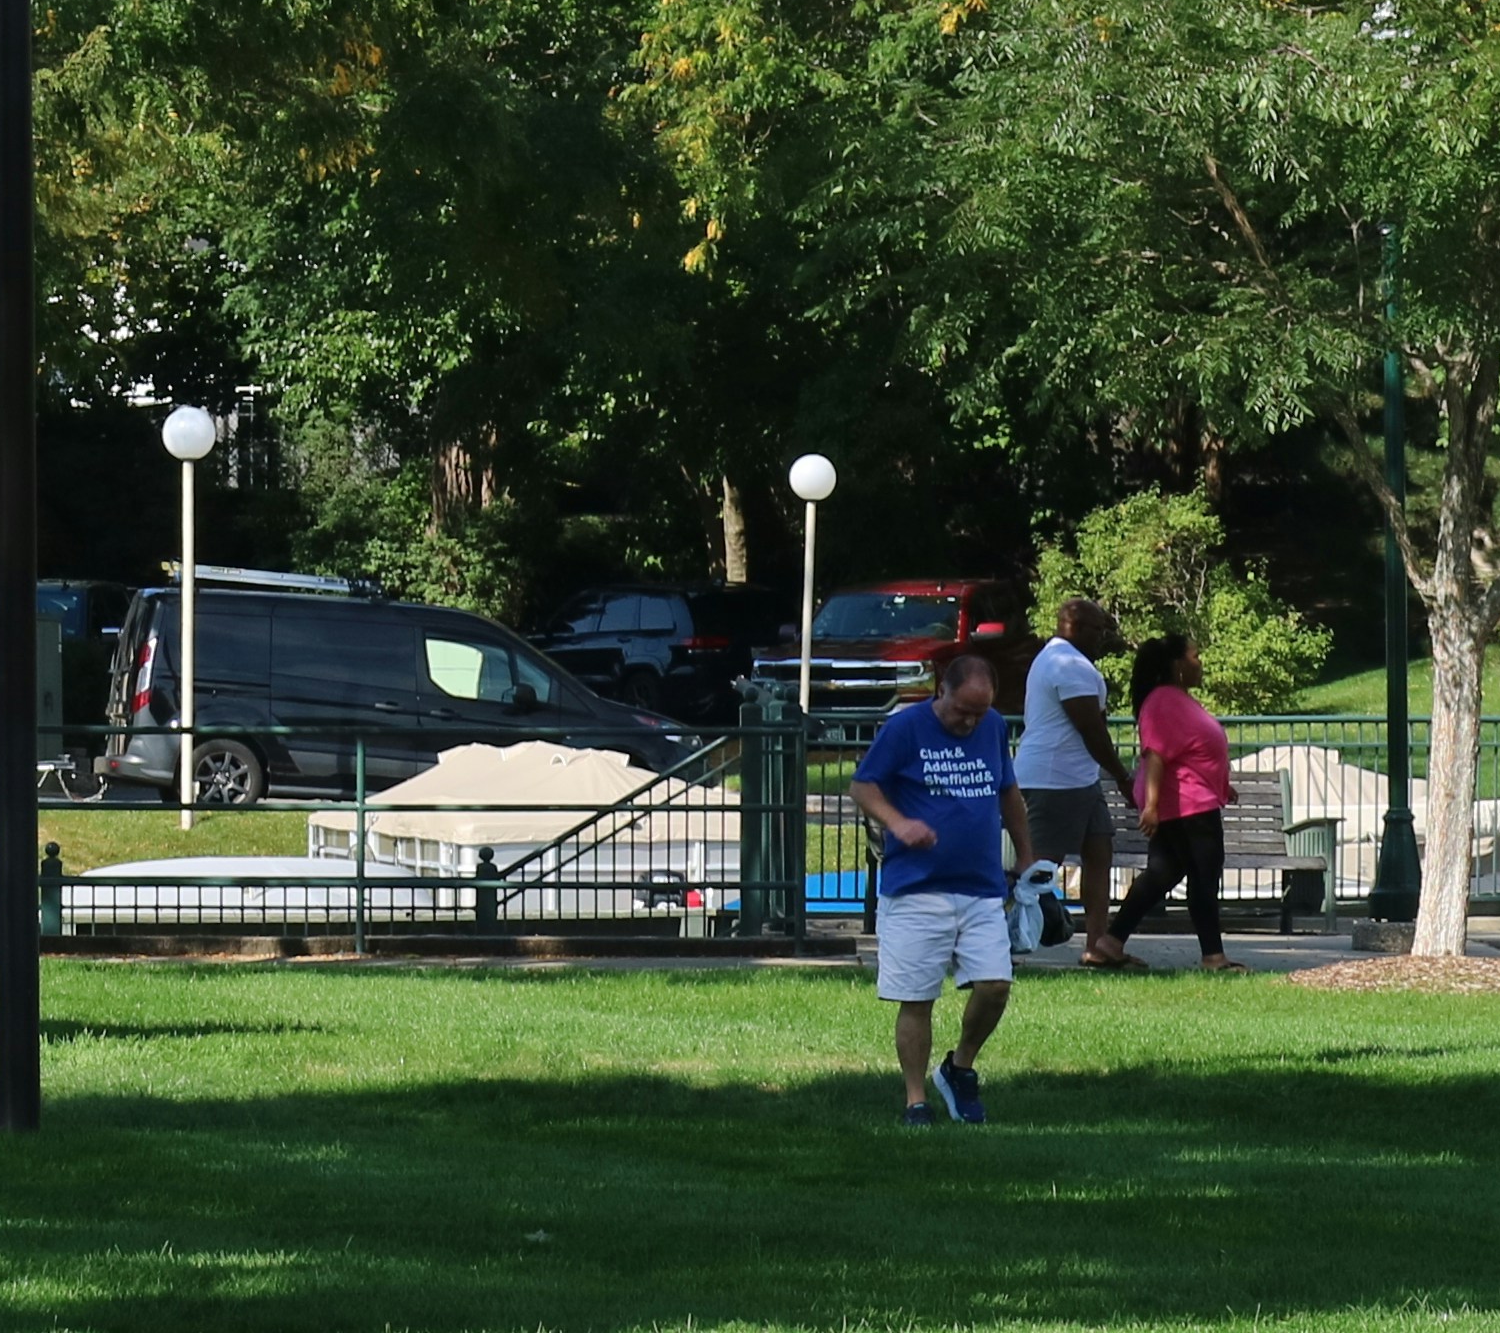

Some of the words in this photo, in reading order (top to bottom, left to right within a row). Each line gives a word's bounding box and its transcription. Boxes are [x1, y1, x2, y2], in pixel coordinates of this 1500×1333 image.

[920, 746, 965, 760] Clark&
[923, 758, 986, 773] Addison&
[924, 771, 994, 785] Sheffield&
